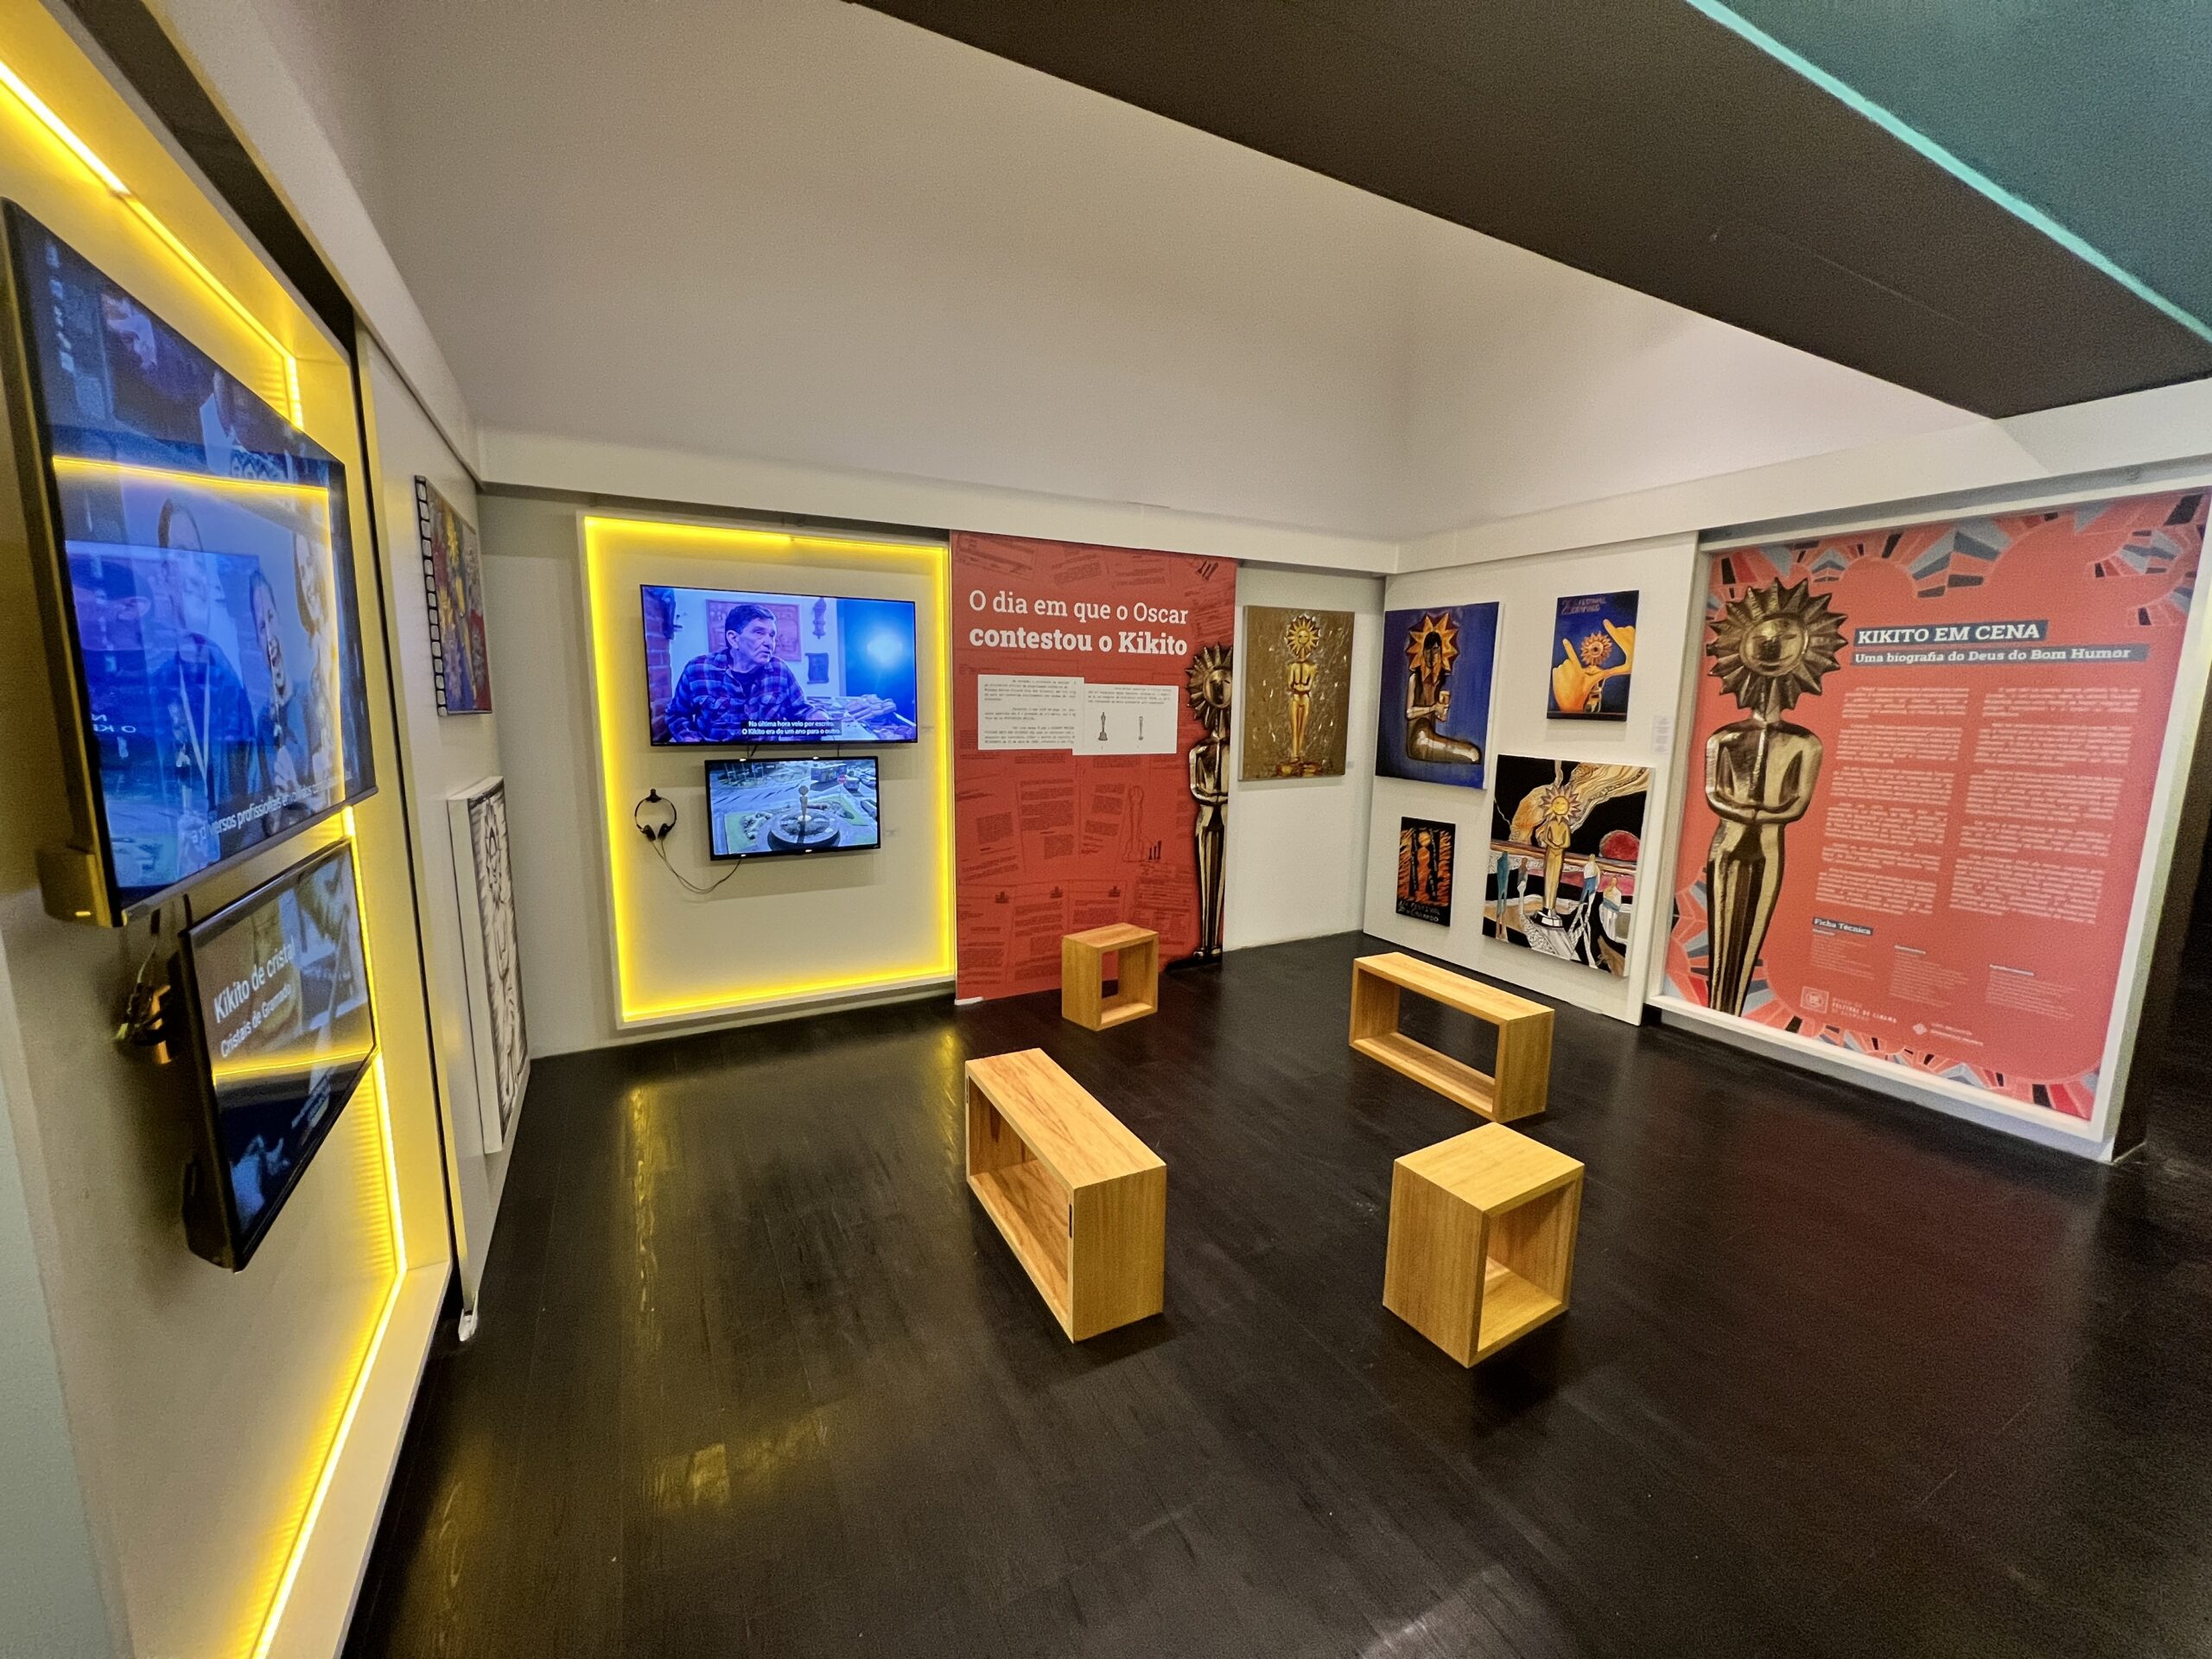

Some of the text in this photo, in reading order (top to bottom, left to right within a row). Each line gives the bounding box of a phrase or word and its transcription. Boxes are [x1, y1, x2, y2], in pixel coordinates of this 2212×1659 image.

[969, 589, 1189, 625] O dia em que o Oscar
[969, 626, 1188, 656] contestou o Kikito
[1858, 623, 2040, 645] KIKITO EM CENA
[1854, 648, 2132, 664] Uma biografia do Deus do Bom Humor
[1814, 918, 1837, 928] Ficha
[1839, 922, 1872, 935] Técnica
[213, 934, 296, 1024] Kikito de cristal
[220, 1019, 252, 1058] Cristais
[251, 1008, 263, 1028] de
